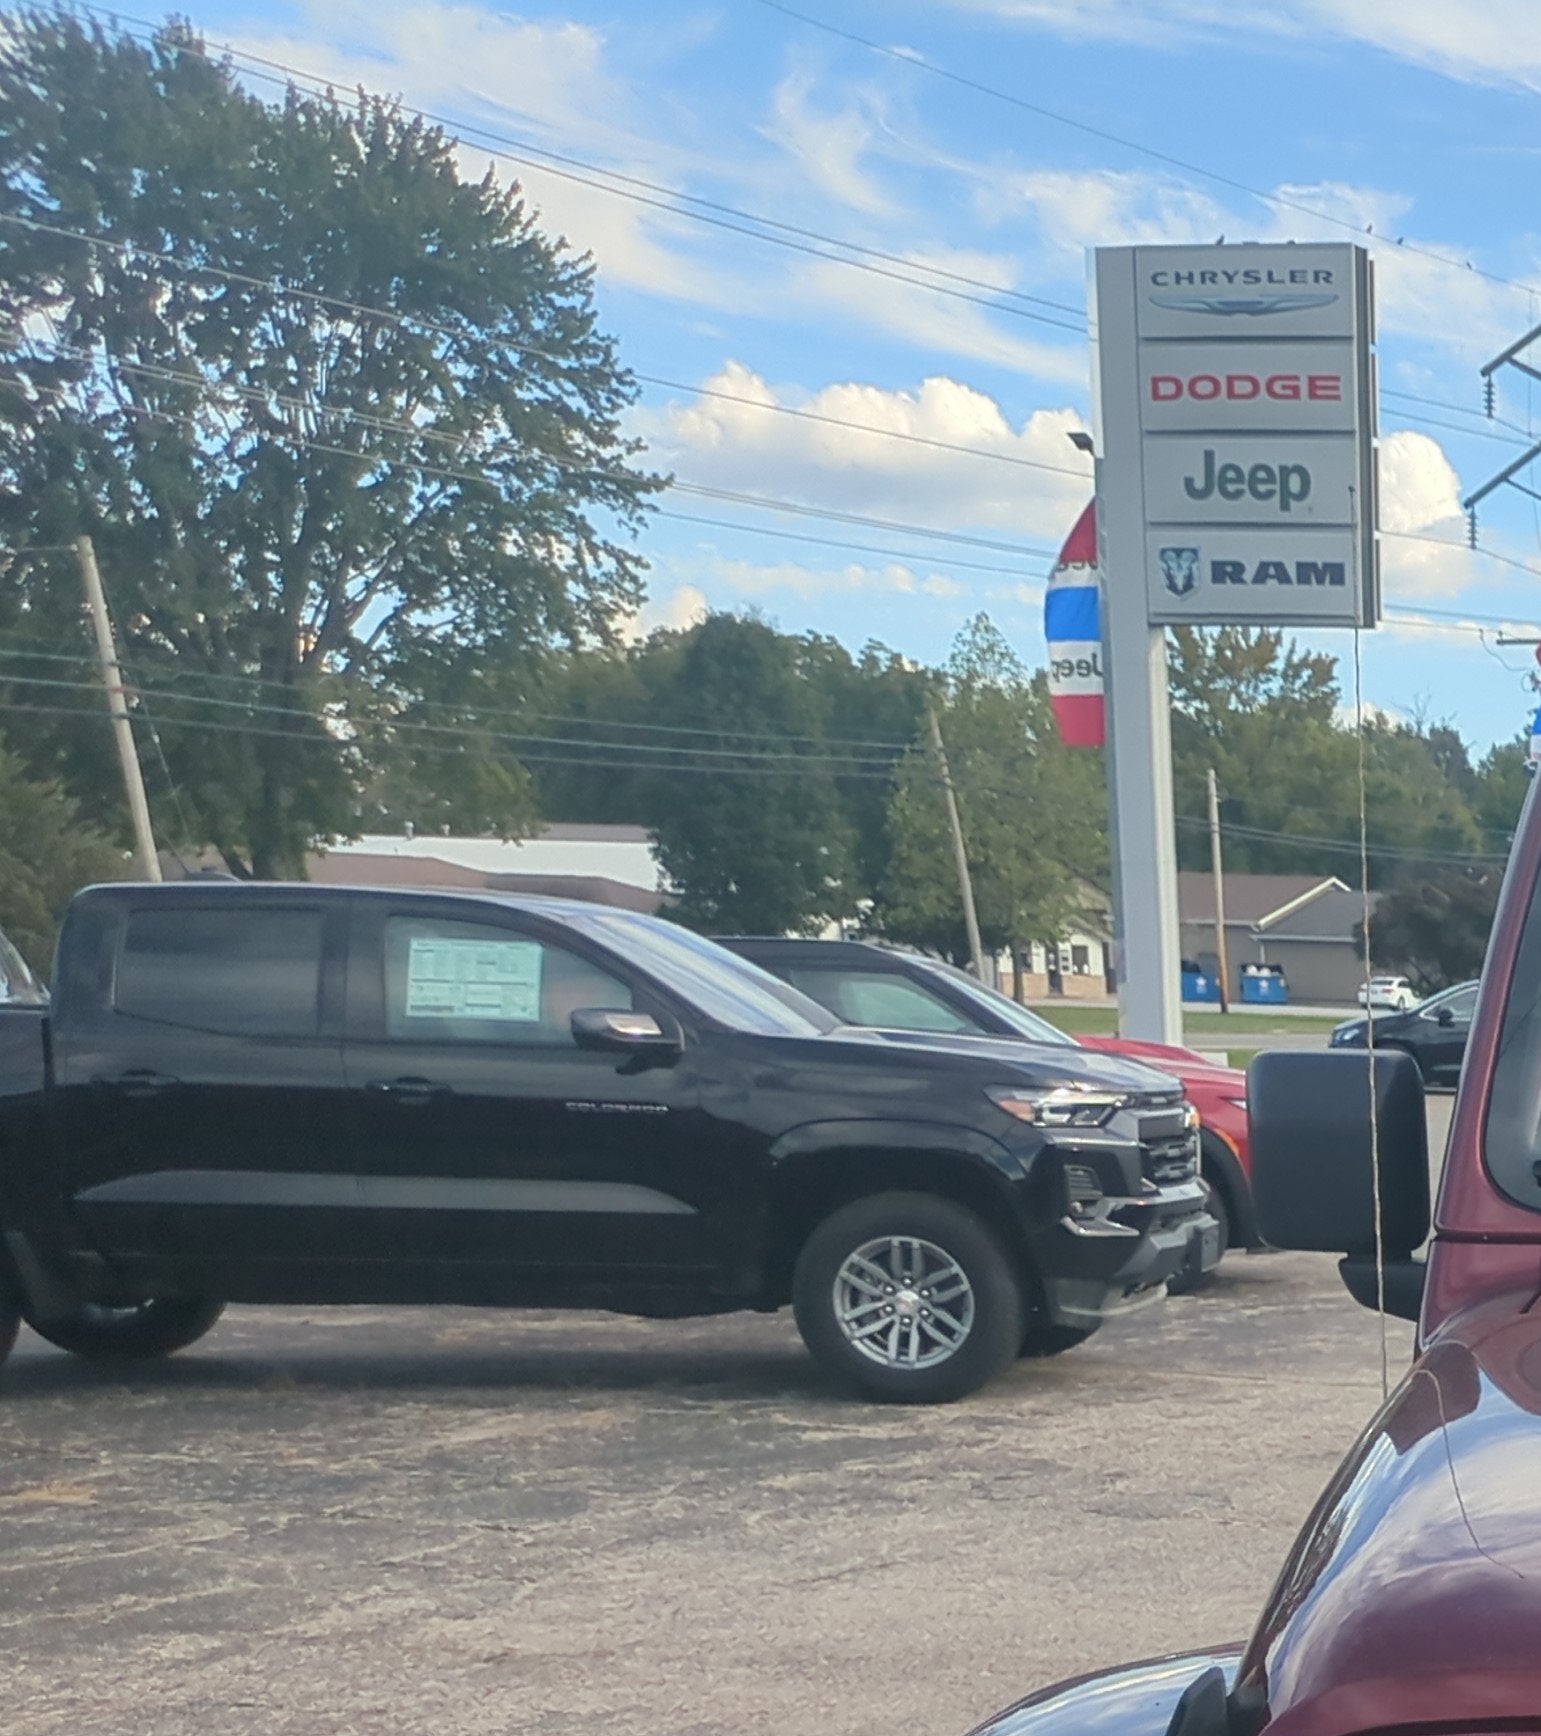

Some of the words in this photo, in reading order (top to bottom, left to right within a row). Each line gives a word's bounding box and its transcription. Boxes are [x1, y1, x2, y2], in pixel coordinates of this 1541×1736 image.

[1151, 269, 1333, 287] CHRYSLER
[1150, 374, 1342, 401] DODGE
[1184, 449, 1312, 512] Jeep
[1210, 560, 1346, 586] RAM
